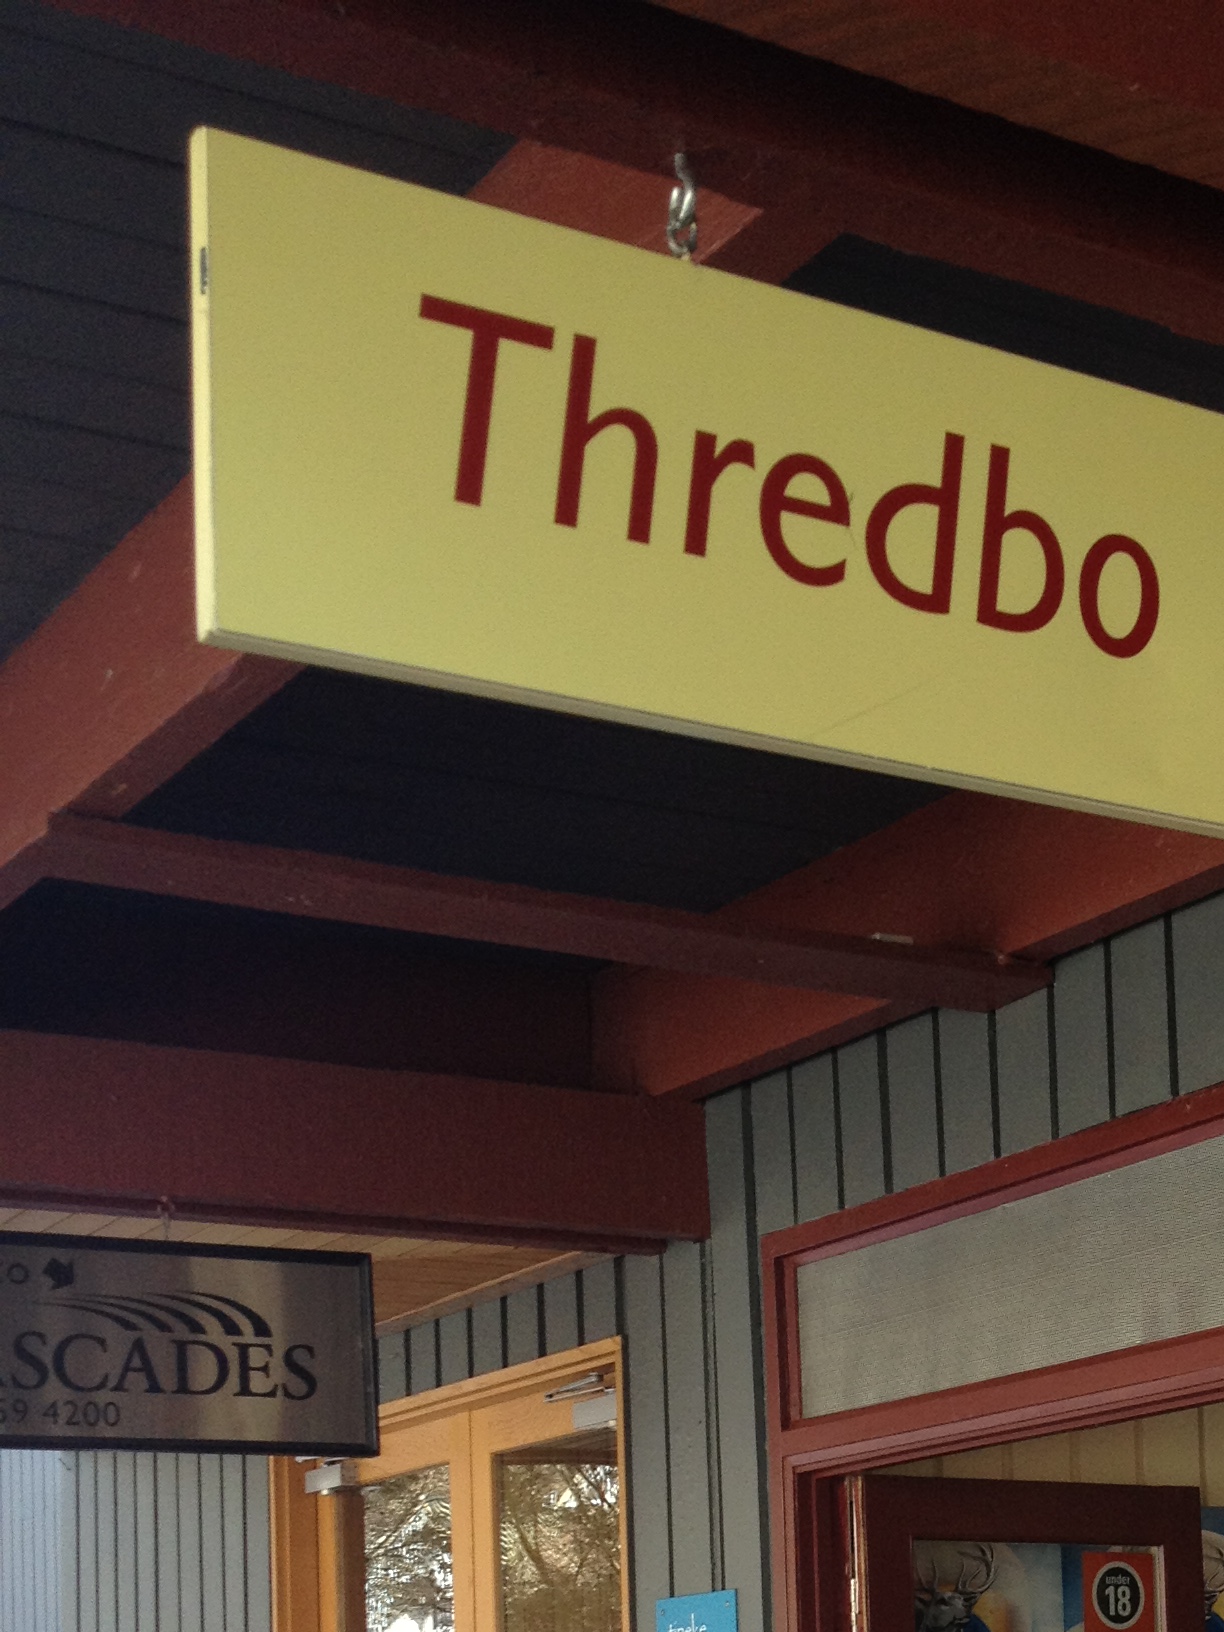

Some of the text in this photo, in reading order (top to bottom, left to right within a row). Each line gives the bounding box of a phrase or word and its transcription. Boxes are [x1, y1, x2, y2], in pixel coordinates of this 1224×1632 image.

[418, 292, 1160, 659] Thredbo
[0, 1262, 30, 1286] O
[0, 1330, 318, 1401] SCADES
[42, 1400, 122, 1428] 4200
[1105, 1573, 1130, 1585] under
[1105, 1585, 1132, 1617] 18
